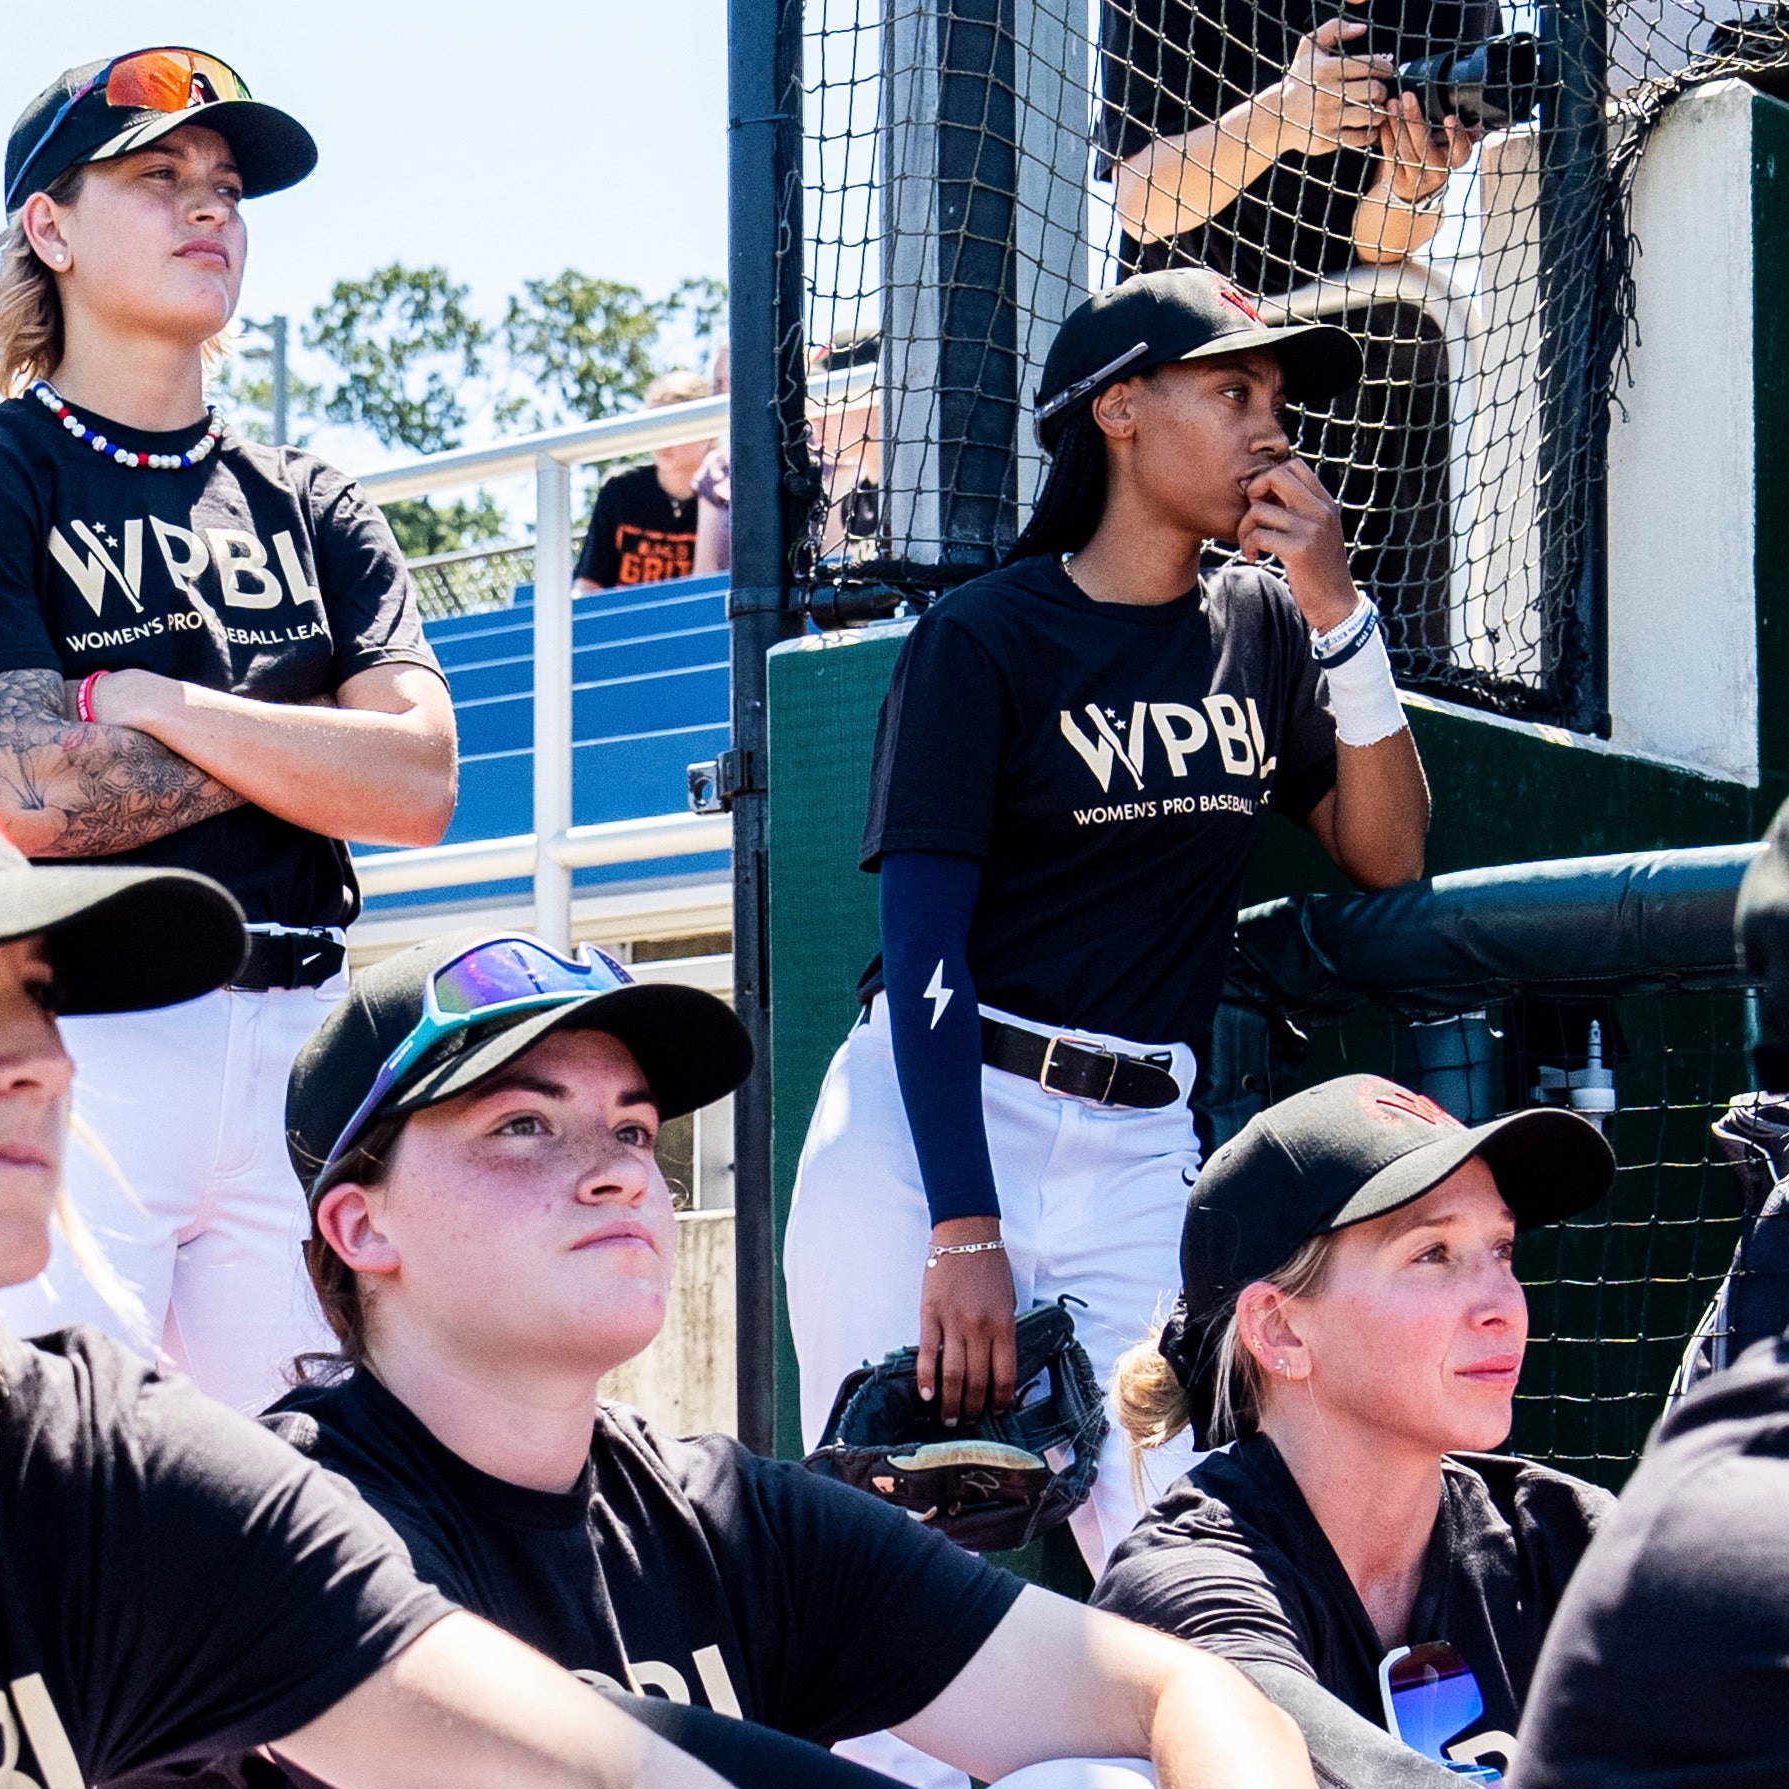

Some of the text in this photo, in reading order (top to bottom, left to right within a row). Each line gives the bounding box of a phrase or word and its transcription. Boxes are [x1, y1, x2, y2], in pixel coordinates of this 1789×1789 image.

[49, 514, 322, 617] WPBL
[65, 616, 165, 653] WOMEN'S
[167, 611, 203, 632] PRO
[1060, 693, 1277, 793] WPBL
[1073, 800, 1157, 827] WOMEN'S
[1162, 796, 1195, 815] PRO
[1199, 794, 1253, 816] BASEBALL
